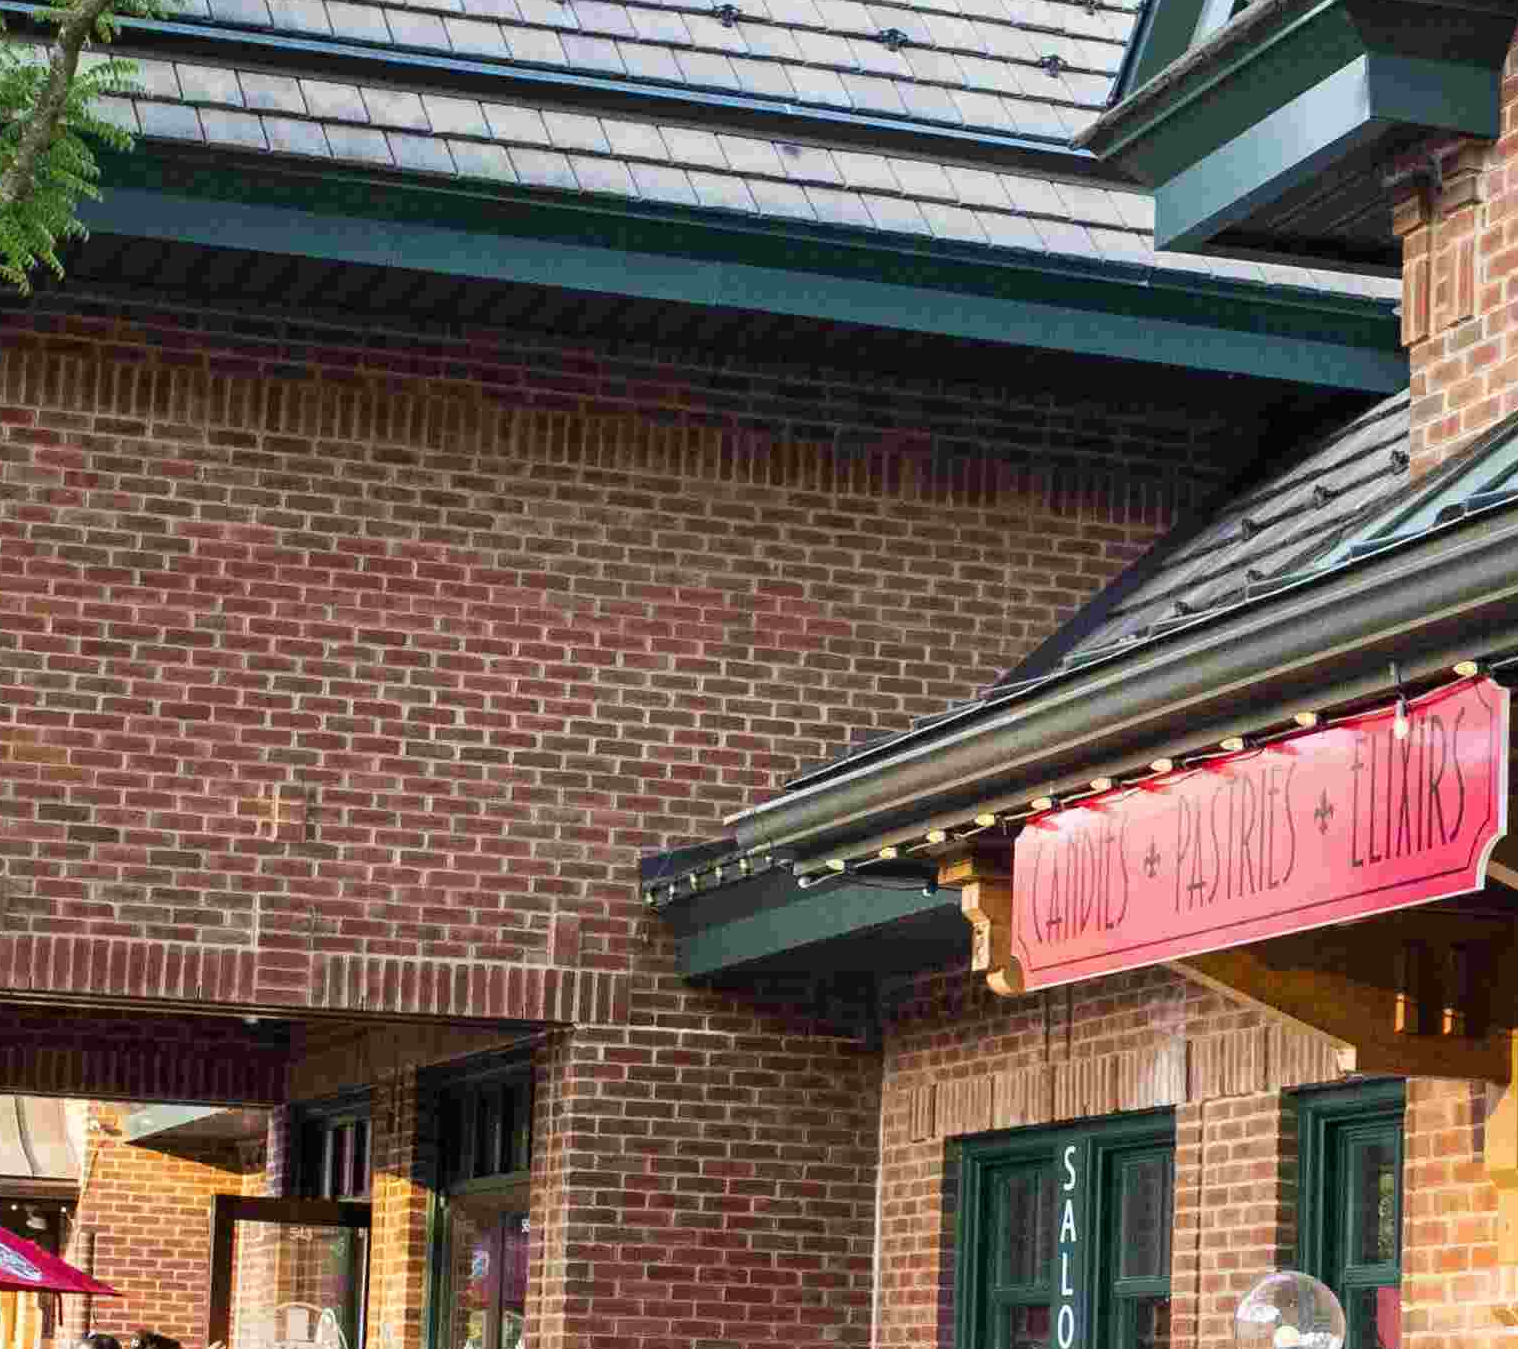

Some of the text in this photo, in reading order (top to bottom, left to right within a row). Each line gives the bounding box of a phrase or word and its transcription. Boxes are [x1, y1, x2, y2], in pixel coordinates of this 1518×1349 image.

[1032, 704, 1467, 944] CANDIES PASTRIES ELIXIRS
